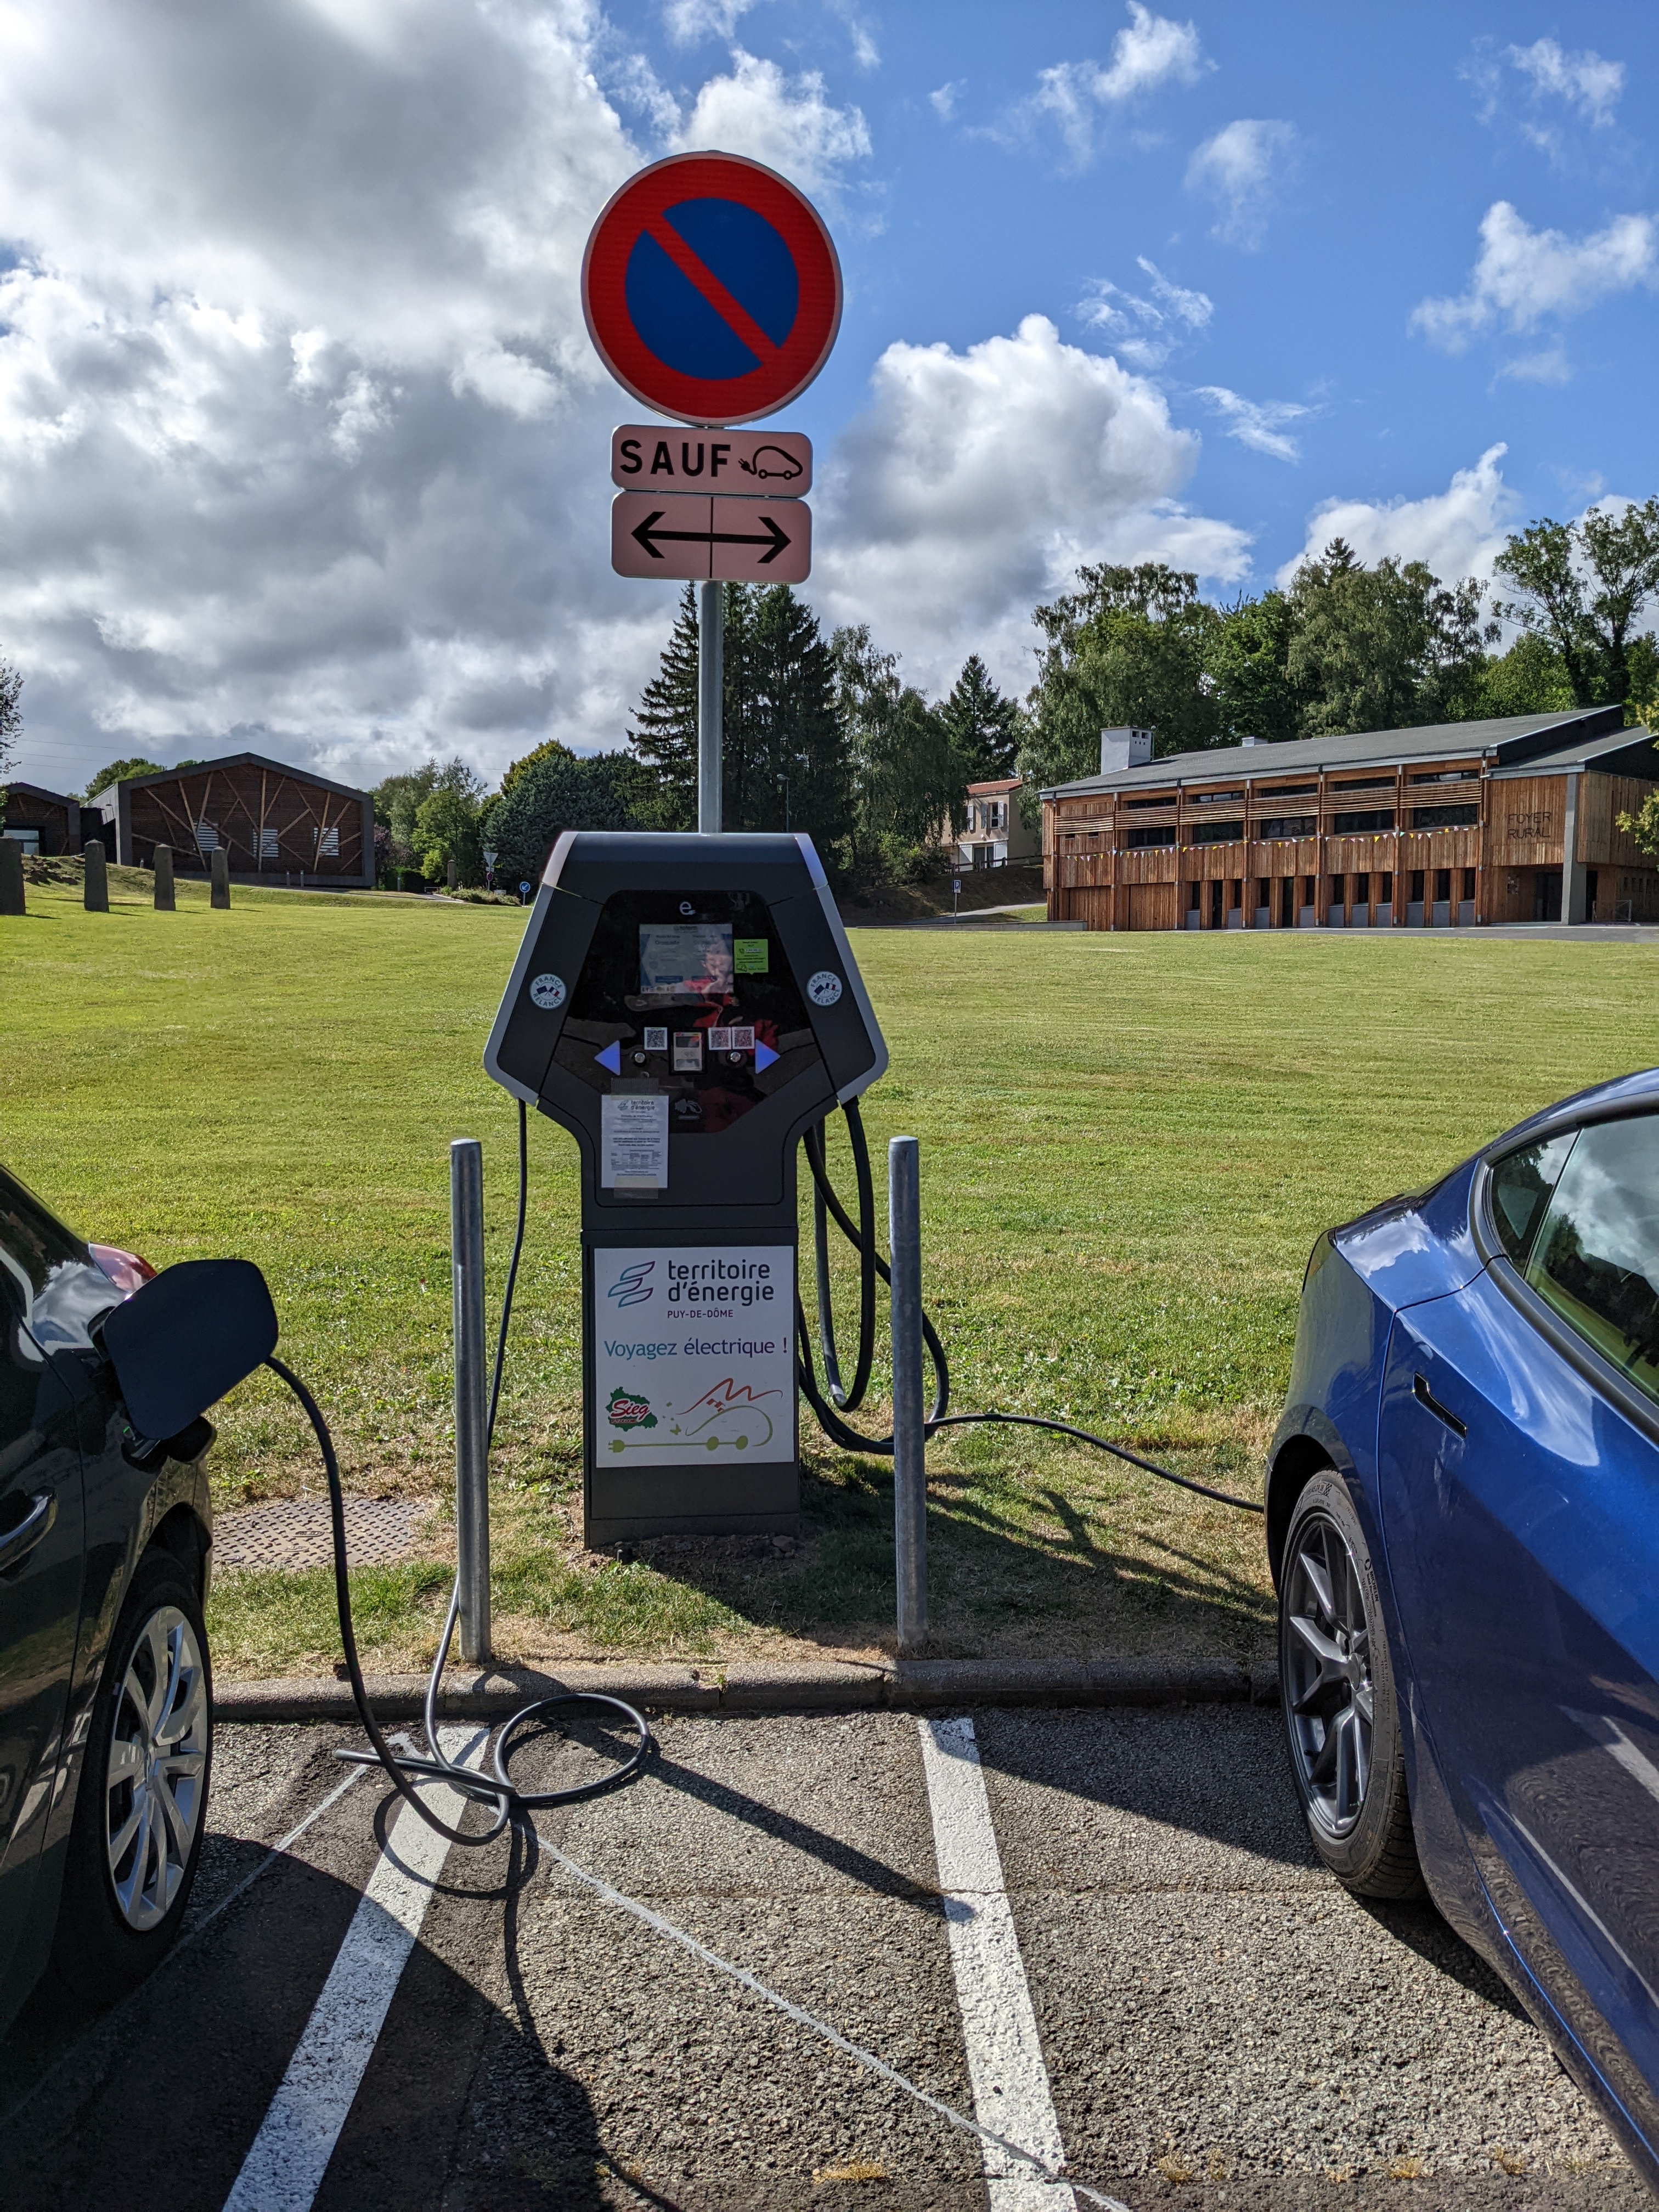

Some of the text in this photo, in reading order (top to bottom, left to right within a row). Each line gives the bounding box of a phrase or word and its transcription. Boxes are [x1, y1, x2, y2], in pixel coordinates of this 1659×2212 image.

[620, 439, 731, 477] SAUF
[1508, 812, 1551, 824] FOYER
[1508, 828, 1550, 839] RURAL
[535, 976, 563, 989] FRANCE
[810, 973, 837, 987] FRANCE
[532, 993, 562, 1007] RELANCE
[813, 989, 840, 1004] RELANCE
[668, 1259, 770, 1280] territoire
[668, 1280, 774, 1306] d'énergie
[667, 1307, 733, 1318] PUY-DE-DÔME
[604, 1340, 678, 1361] Voyagez
[684, 1338, 775, 1358] électrique
[611, 1400, 650, 1420] Sieg
[1370, 1571, 1379, 1602] MICHELIN
